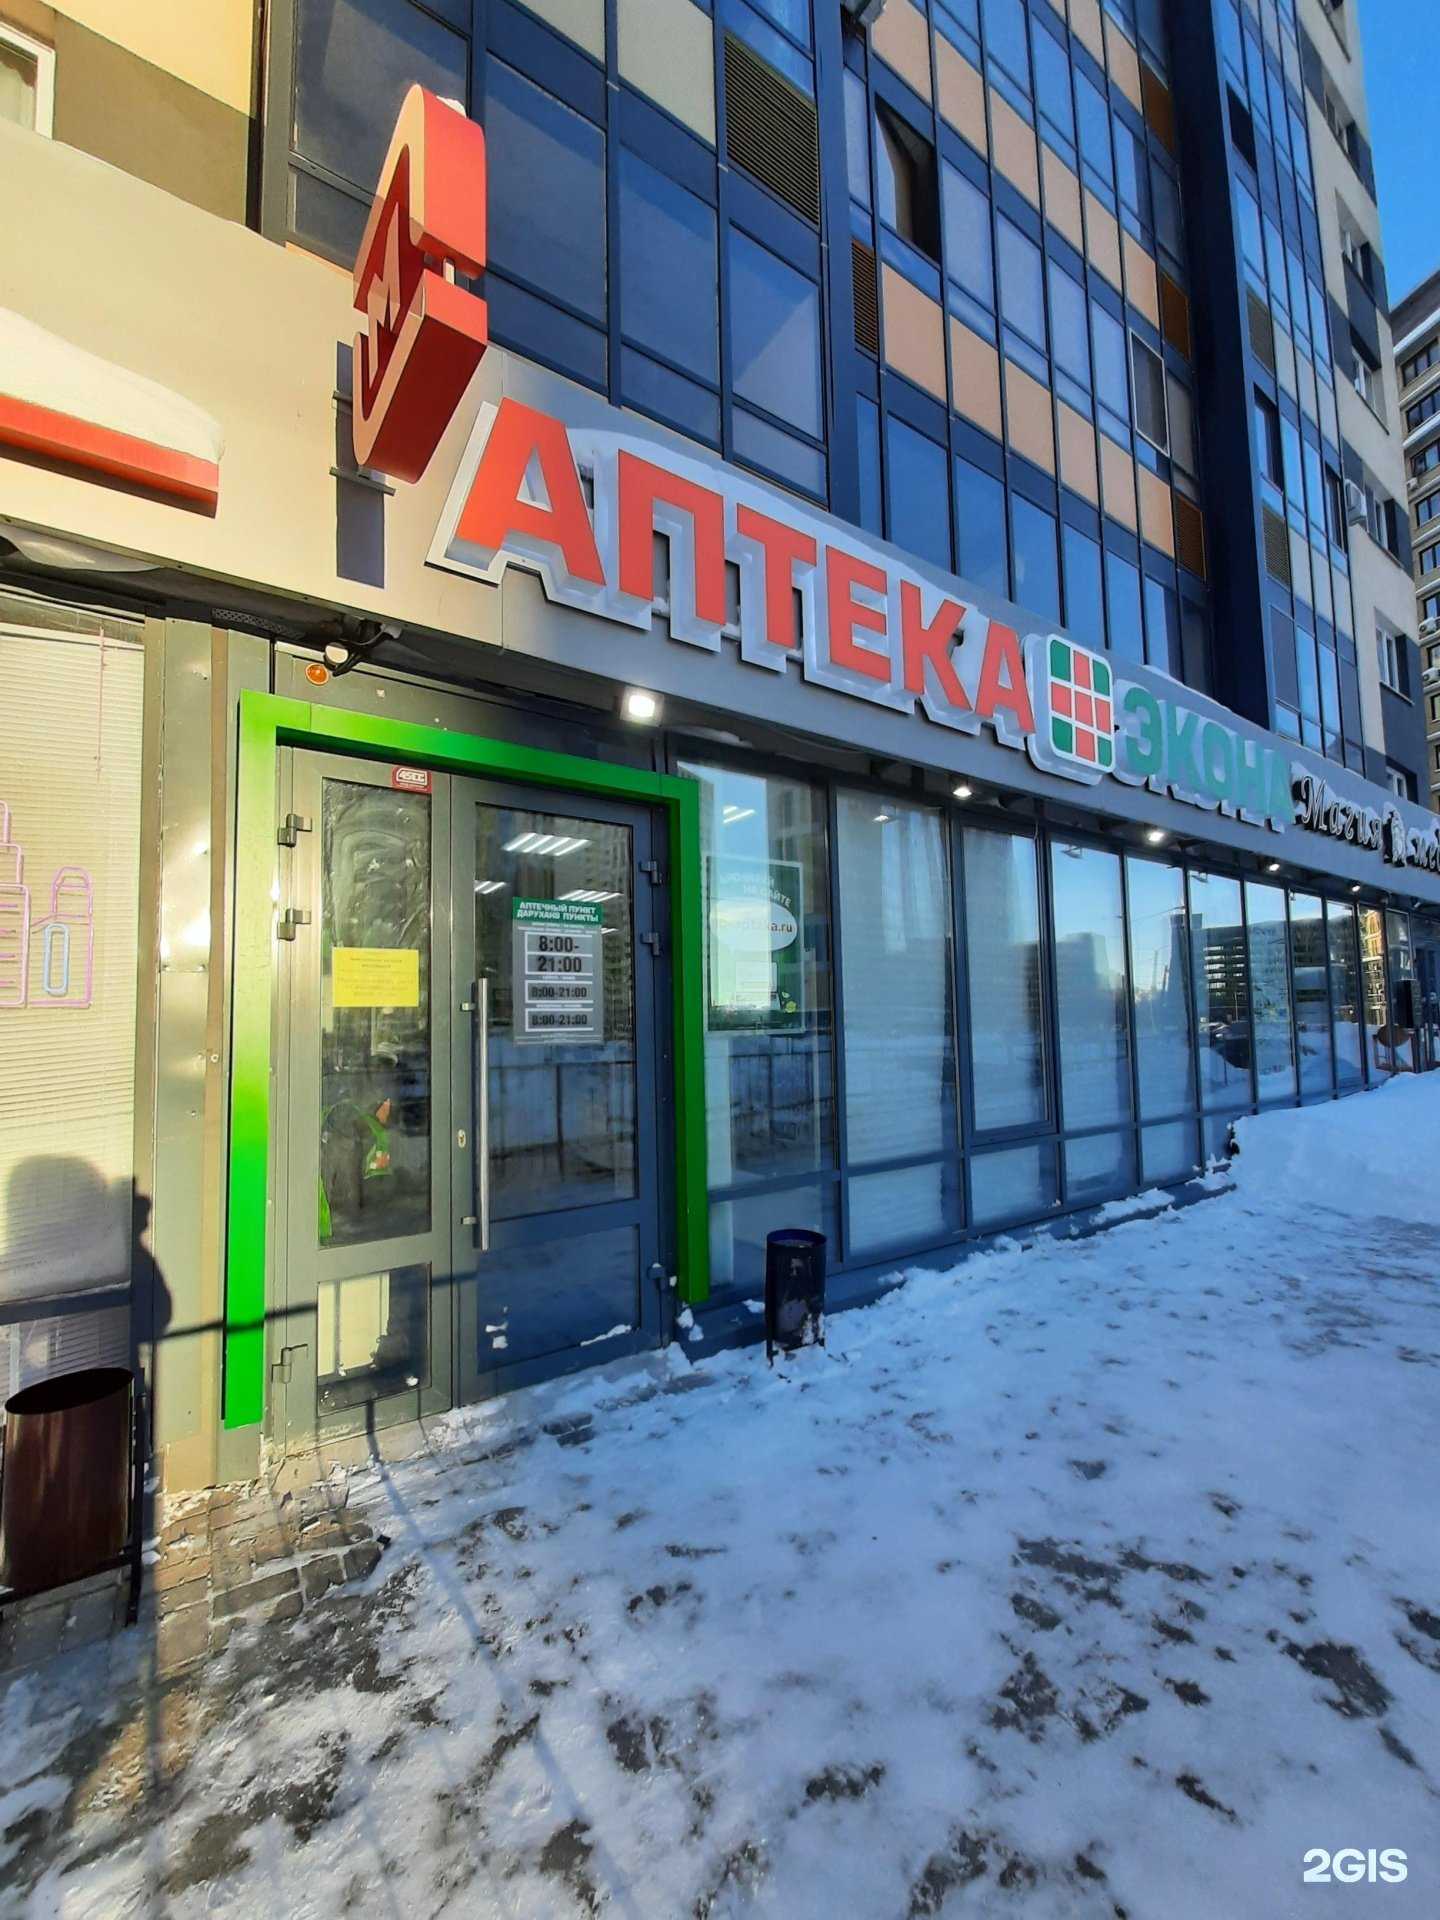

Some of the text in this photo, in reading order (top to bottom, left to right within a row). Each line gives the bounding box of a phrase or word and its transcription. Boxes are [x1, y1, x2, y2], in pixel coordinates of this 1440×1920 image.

[455, 396, 1296, 827] АПТЕКА ЭКОНА
[519, 901, 597, 914] АПТЕЧНЫЙ ПУНКТ
[562, 912, 599, 922] ПУНКТЫ
[538, 935, 580, 953] 8:00-
[537, 955, 582, 973] 21:00
